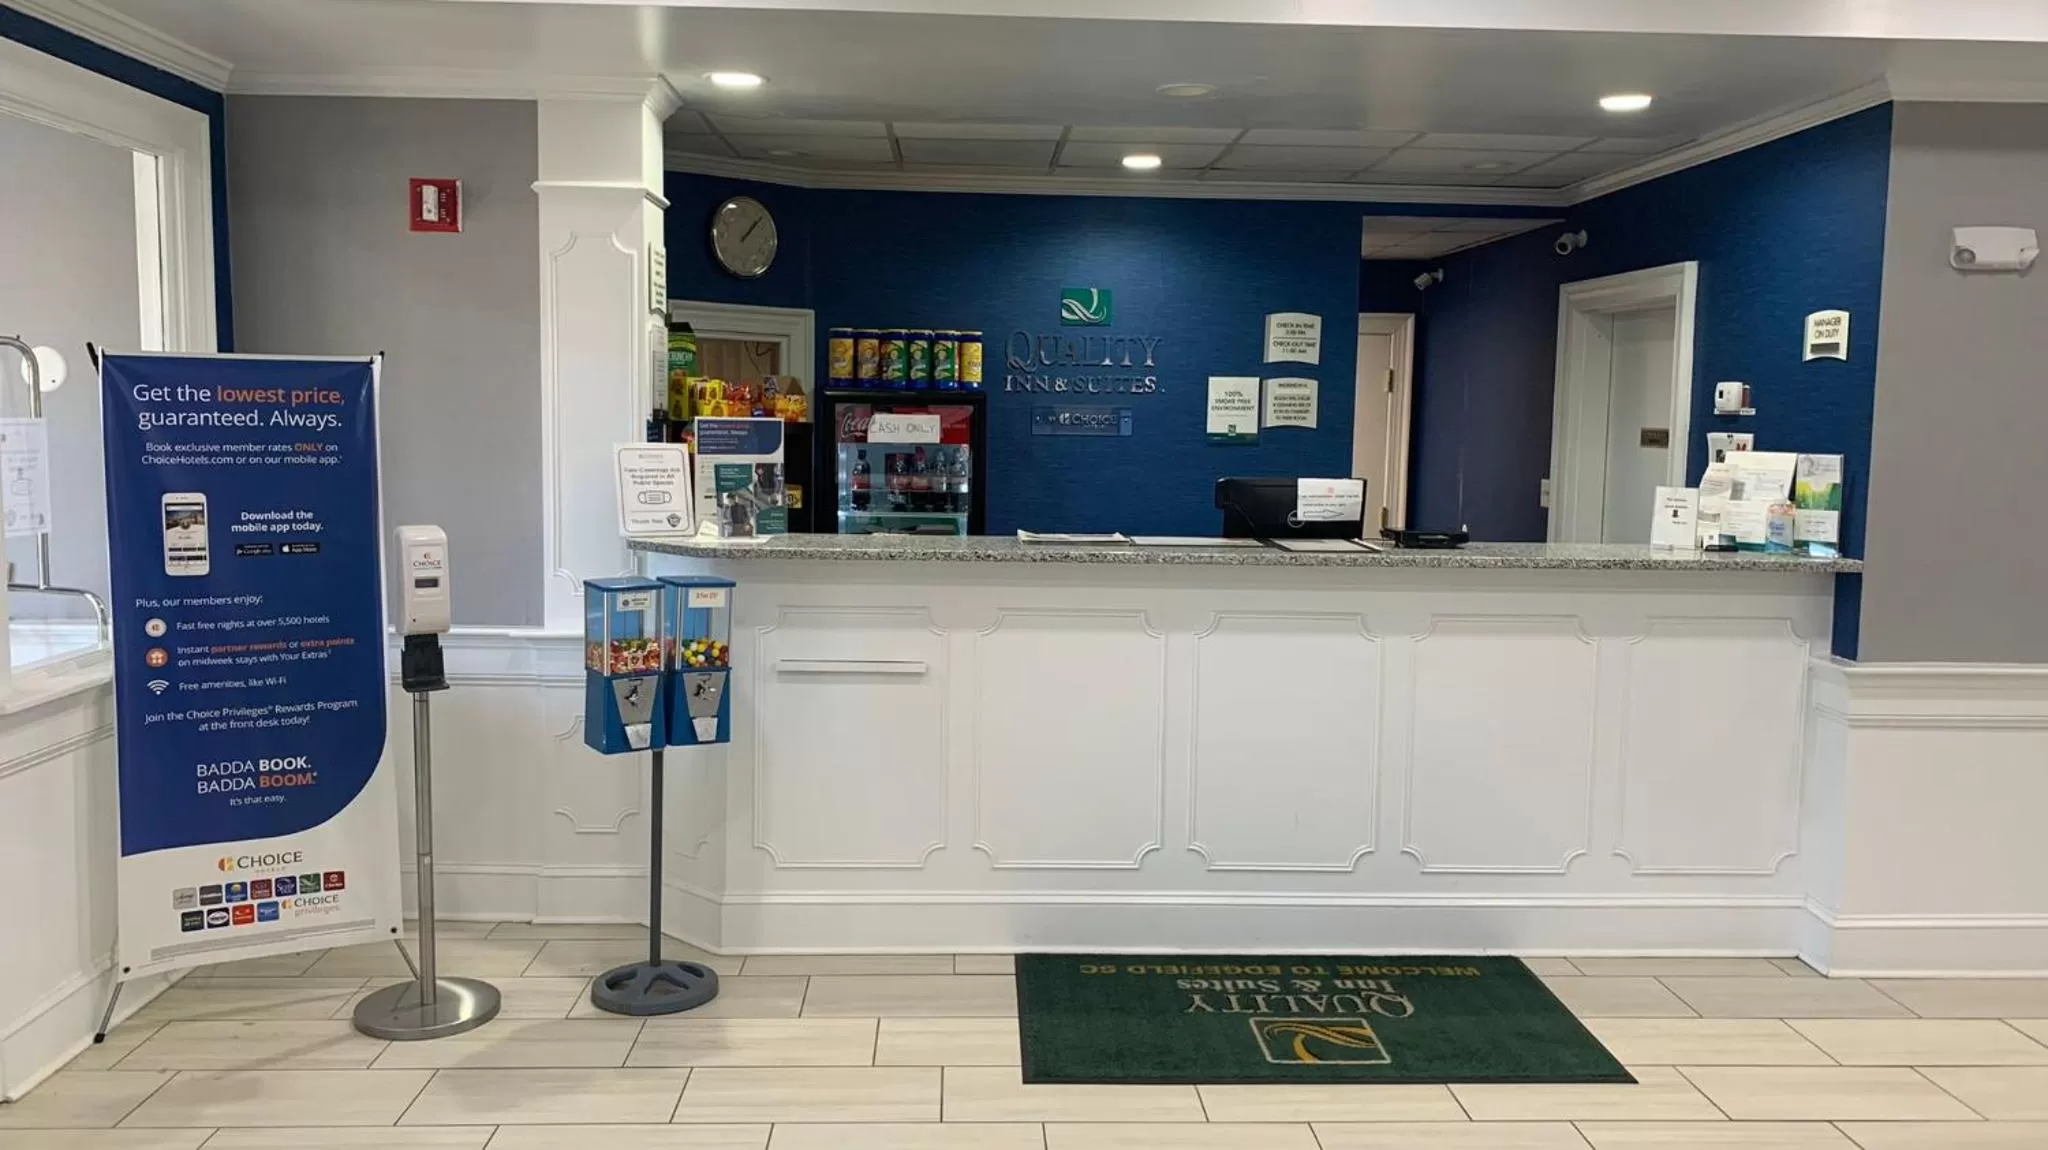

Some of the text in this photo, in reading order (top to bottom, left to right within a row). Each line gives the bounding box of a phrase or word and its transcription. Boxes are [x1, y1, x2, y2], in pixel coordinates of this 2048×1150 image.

[1814, 316, 1842, 327] MANAGER
[1815, 328, 1840, 339] ON DUTY
[1005, 330, 1163, 373] QUALITY
[1004, 375, 1050, 393] INN
[1055, 376, 1068, 392] &
[133, 384, 345, 408] Get the lowest price,
[138, 410, 342, 431] guaranteed. Always.
[1072, 413, 1117, 424] CHOICE
[869, 420, 936, 434] CASH ONLY
[145, 442, 173, 452] Book
[174, 442, 220, 452] exclusive
[222, 443, 266, 452] member
[268, 443, 292, 452] rates
[294, 443, 323, 452] ONLY
[141, 455, 233, 465] ChoiceHotels.com
[284, 456, 317, 465] mobile
[241, 510, 313, 520] Download the
[231, 522, 324, 533] mobile app today.
[135, 598, 160, 608] Plus,
[162, 598, 180, 607] our
[183, 596, 231, 606] members
[176, 622, 195, 630] Fast
[197, 621, 215, 630] free
[217, 620, 245, 631] nights
[278, 617, 301, 626] 5,500
[303, 614, 330, 624] hotels
[177, 646, 209, 654] Instant
[178, 659, 190, 667] on
[192, 656, 233, 666] midweek
[235, 656, 258, 666] stays
[260, 653, 279, 662] with
[279, 652, 300, 661] Your
[178, 676, 287, 690] Free amenities, like Wi-Fi
[144, 713, 165, 726] Join
[167, 712, 184, 721] the
[186, 709, 221, 719] Choice
[275, 703, 315, 714] Rewards
[317, 700, 358, 711] Program
[198, 716, 311, 731] at the front desk today!
[196, 756, 312, 777] BADDA BOOK.
[197, 777, 256, 794] BADDA
[243, 796, 262, 805] that
[264, 795, 287, 804] easy.
[237, 851, 303, 869] CHOICE
[294, 895, 339, 907] CHOICE
[294, 905, 340, 918] privileges
[1080, 964, 1481, 976] WELCOME TO EDGEFIELD SC
[1176, 978, 1395, 993] Inn & Suites
[1184, 991, 1415, 1018] QUALITY
